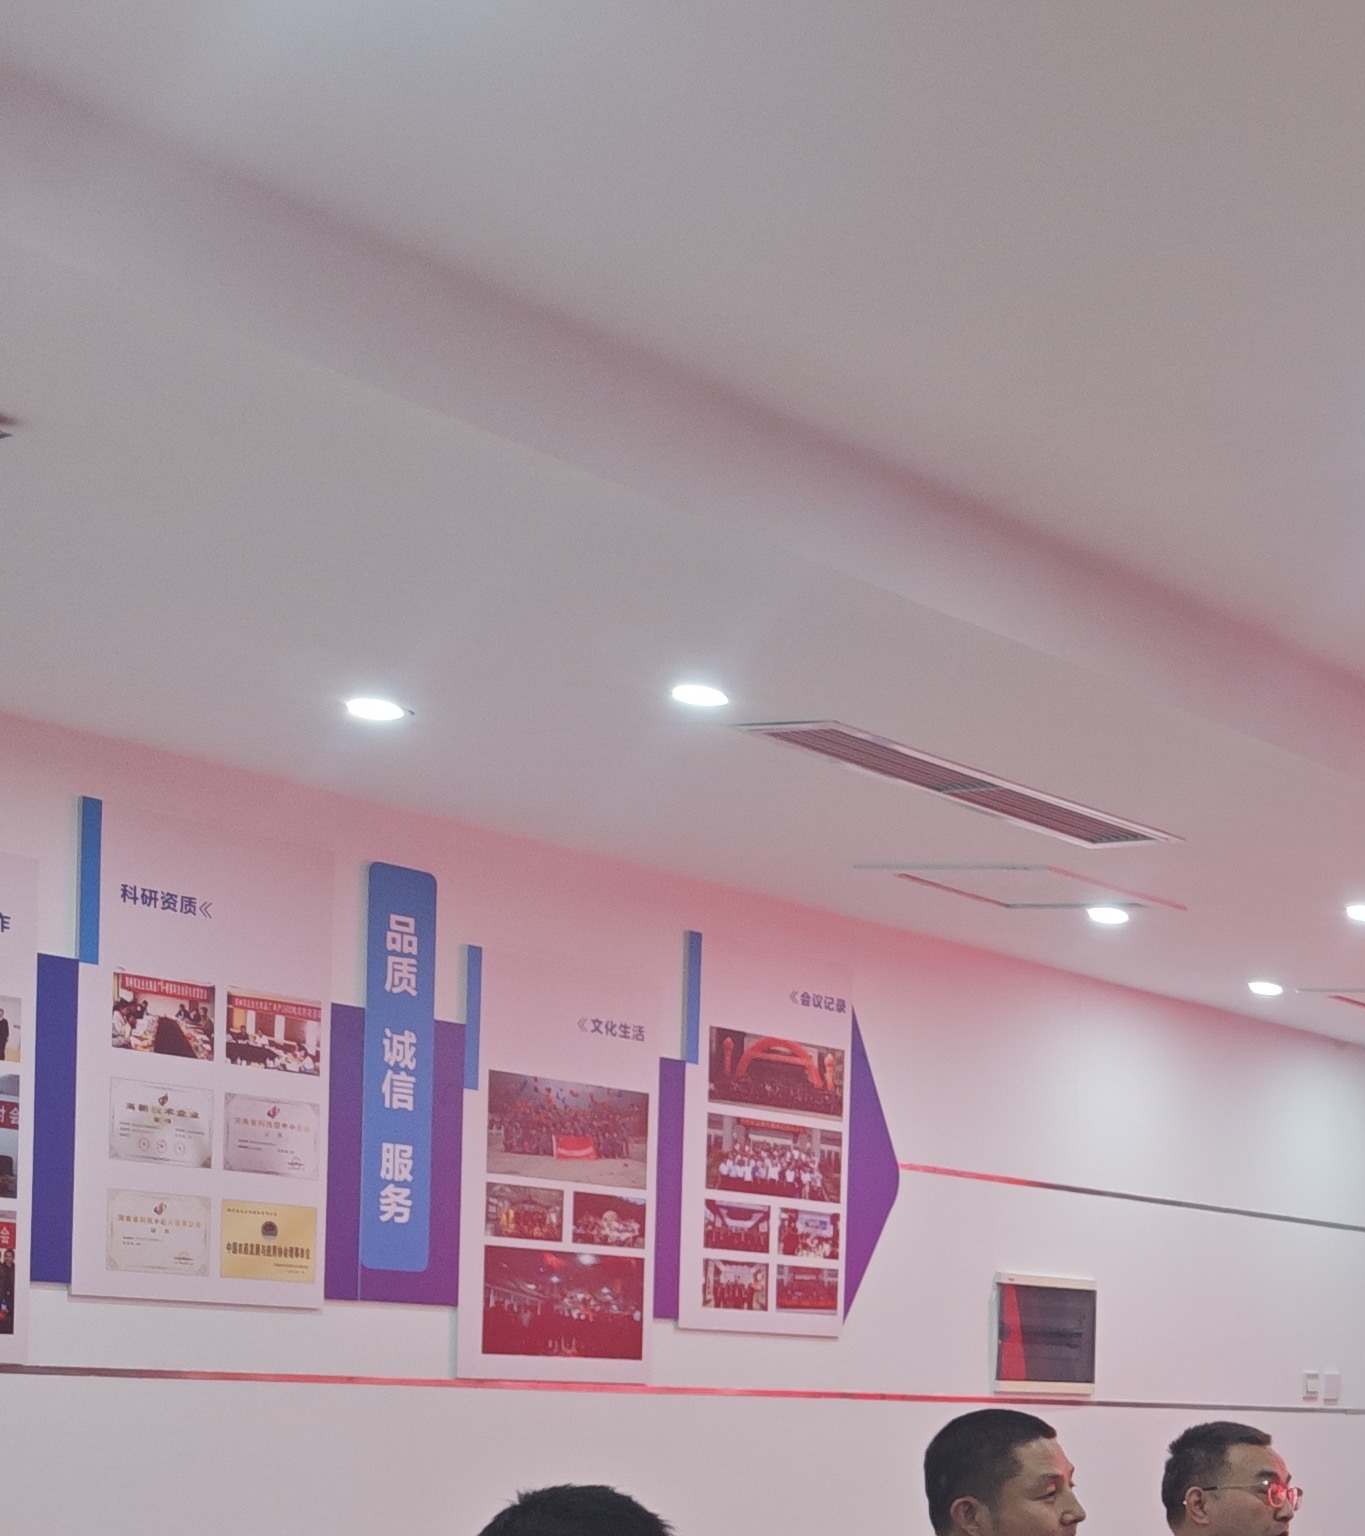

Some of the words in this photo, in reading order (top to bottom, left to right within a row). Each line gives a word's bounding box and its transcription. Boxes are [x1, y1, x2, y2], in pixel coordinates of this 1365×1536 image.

[120, 883, 198, 916] 科研资质
[384, 913, 418, 997] 品质
[590, 1018, 646, 1042] 文化生活
[800, 991, 847, 1014] 会议记录
[381, 1027, 417, 1112] 诚信
[379, 1142, 413, 1224] 服务
